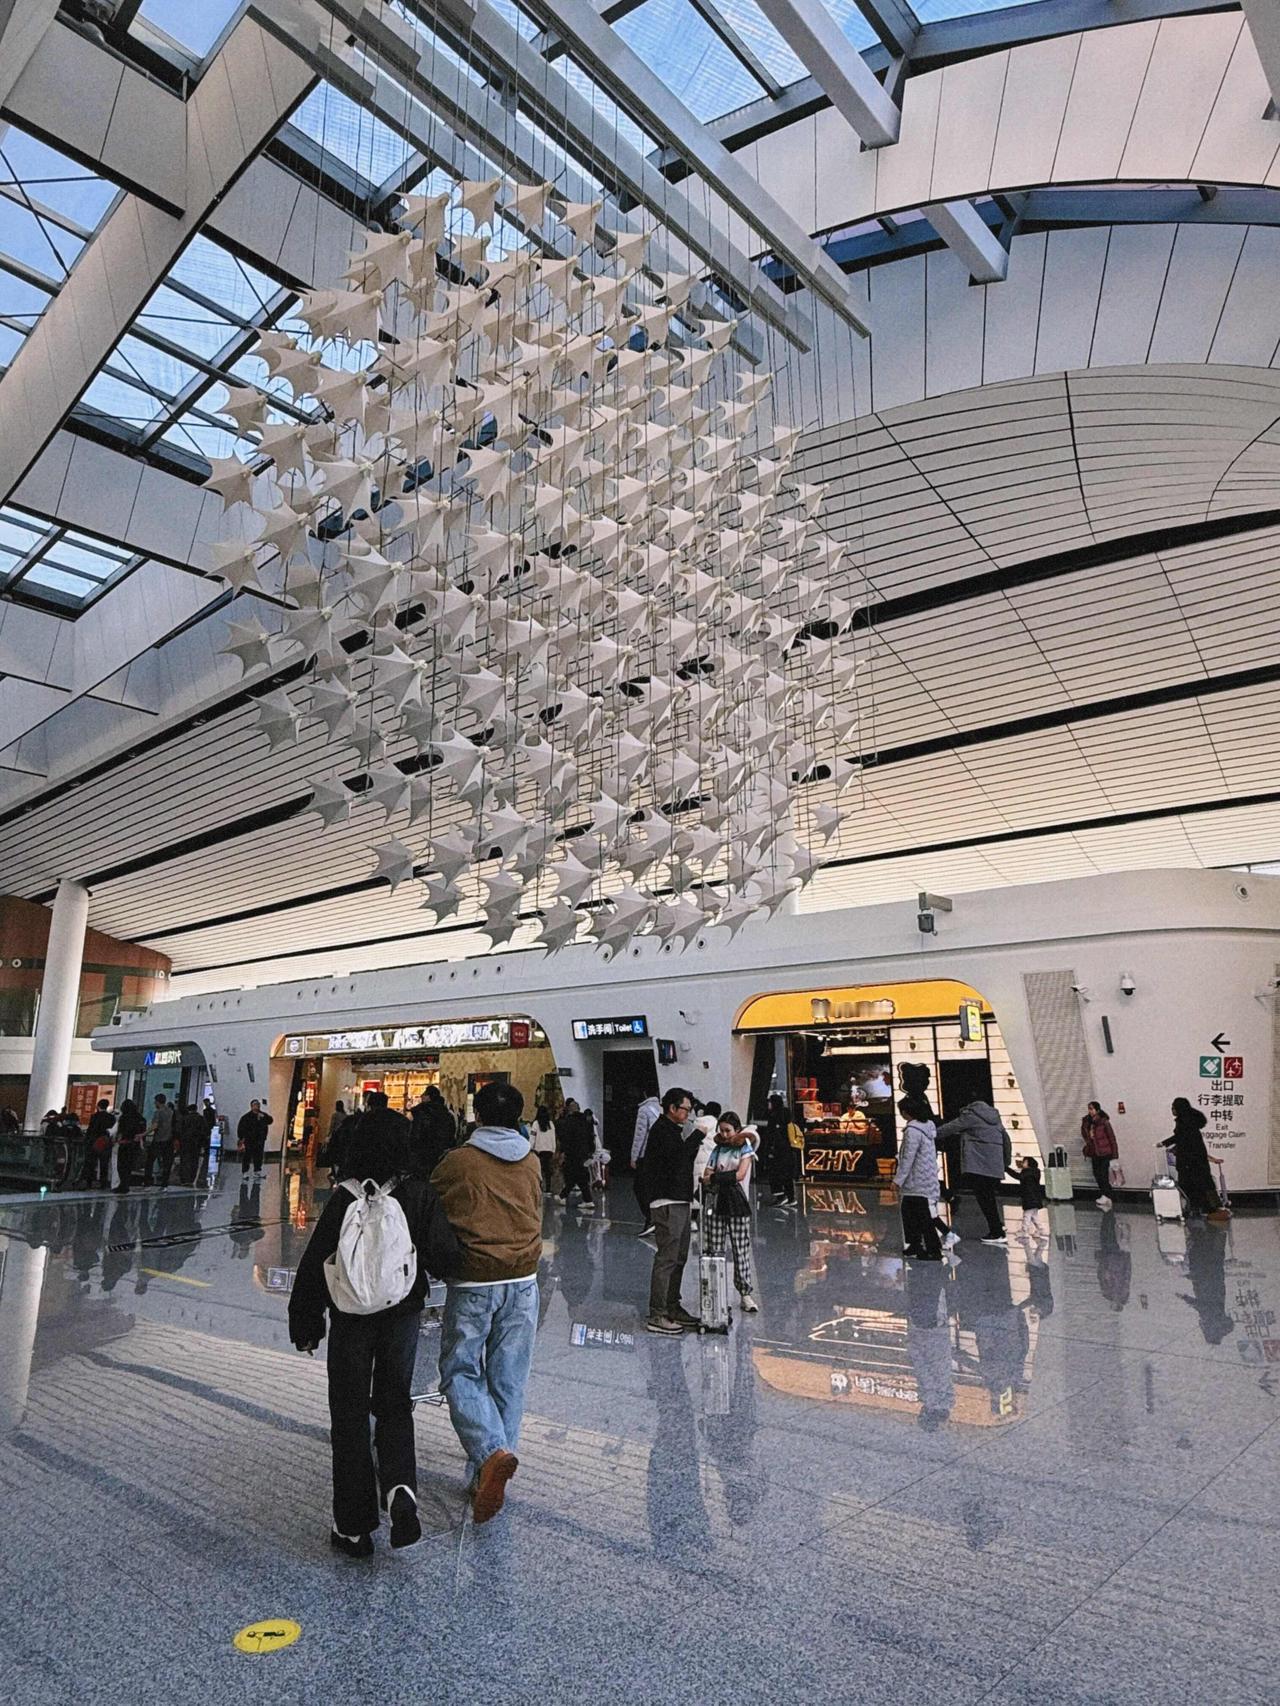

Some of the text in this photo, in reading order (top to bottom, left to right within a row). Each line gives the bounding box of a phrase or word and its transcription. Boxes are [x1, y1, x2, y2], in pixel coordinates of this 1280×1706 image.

[588, 1023, 612, 1035] 洗手间
[615, 1023, 632, 1032] Toilet
[1211, 1080, 1234, 1091] 出口
[1198, 1094, 1244, 1106] 行李提取
[1210, 1109, 1233, 1121] 中转
[1216, 1123, 1229, 1131] Exit
[1208, 1141, 1236, 1149] Transfer
[806, 1149, 863, 1172] ZHY
